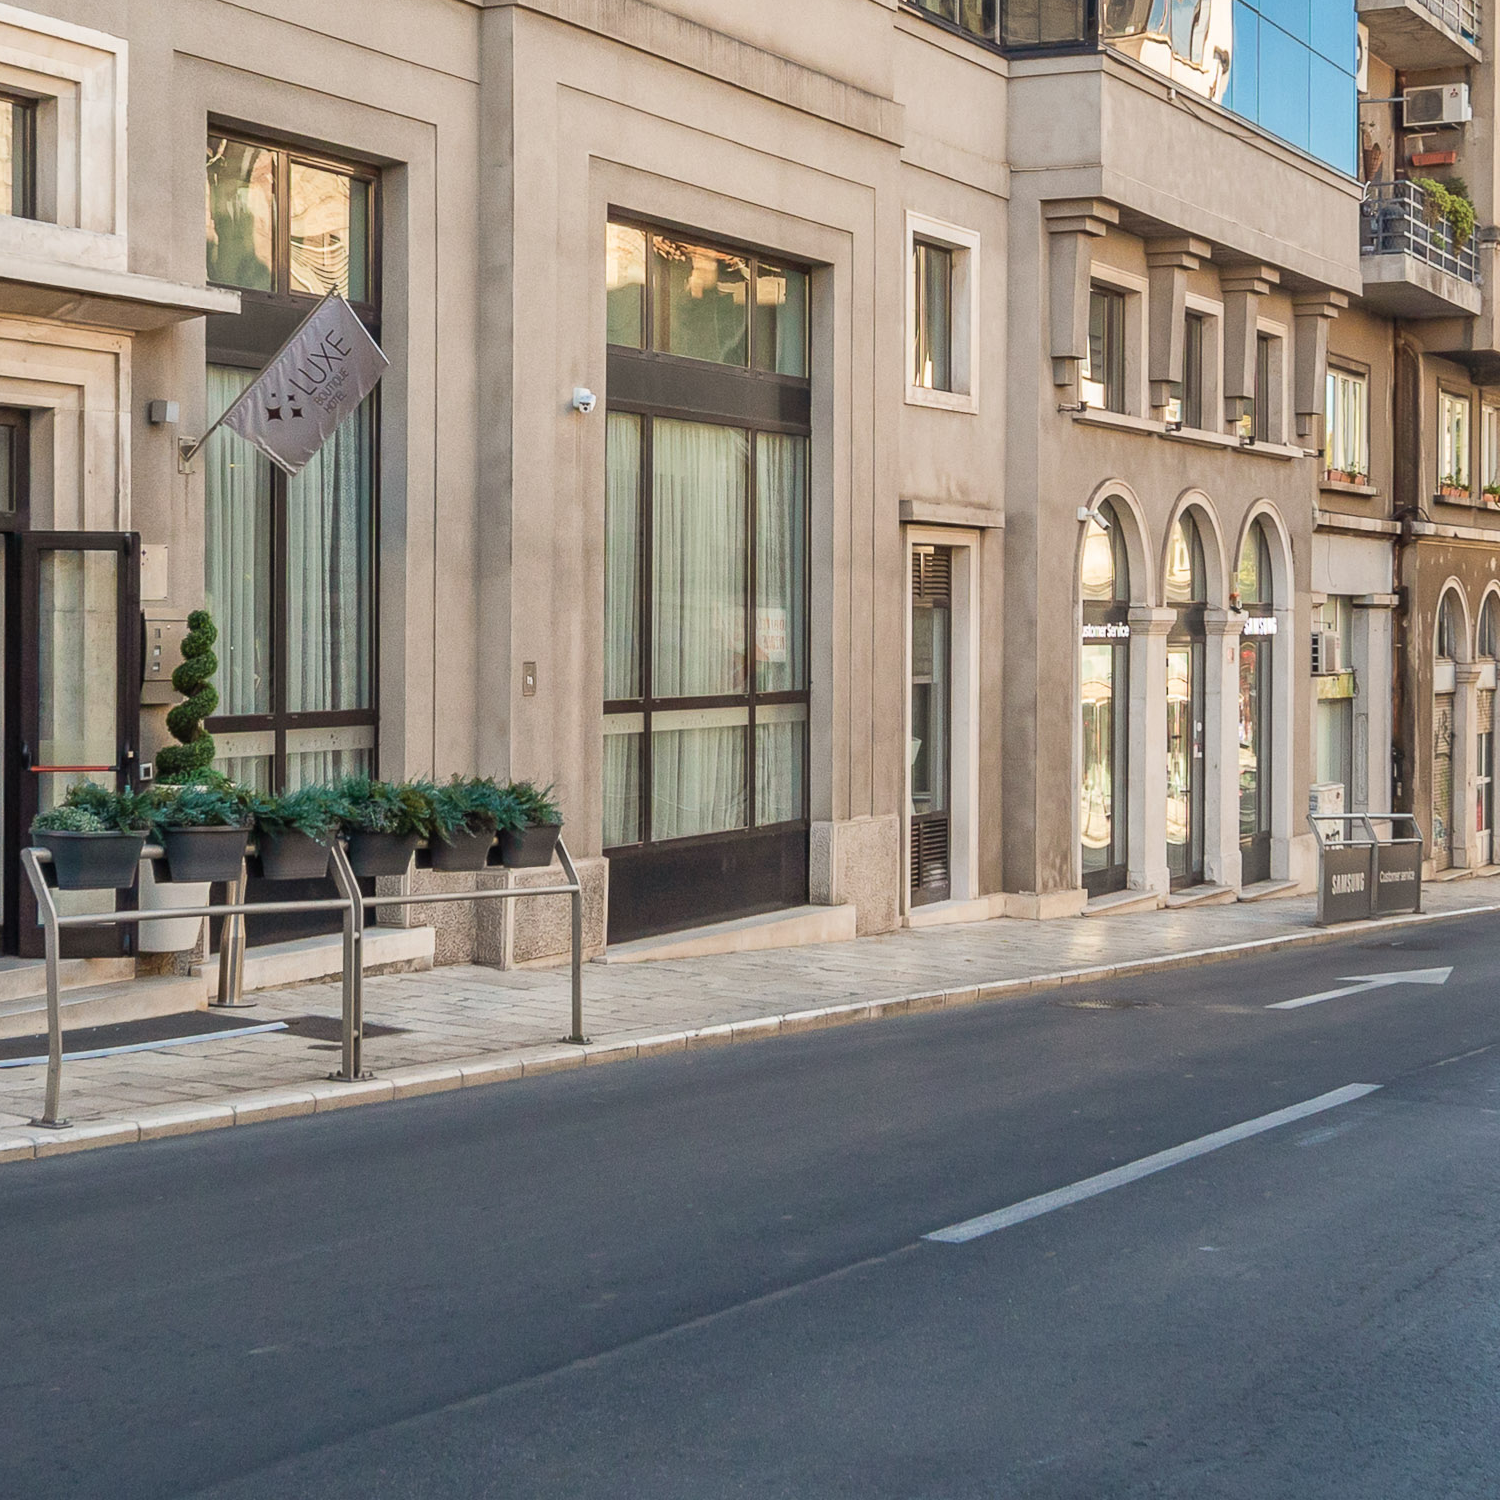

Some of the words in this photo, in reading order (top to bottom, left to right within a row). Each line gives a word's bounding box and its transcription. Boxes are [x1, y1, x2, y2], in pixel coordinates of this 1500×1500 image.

[288, 328, 352, 396] LUXE
[314, 367, 350, 406] BOUTIQUE
[323, 392, 347, 414] HOTEL
[1082, 623, 1107, 638] ustomer
[1106, 621, 1130, 638] Service
[1243, 617, 1278, 636] SAMSUNG
[1331, 872, 1365, 896] SAMSUNG
